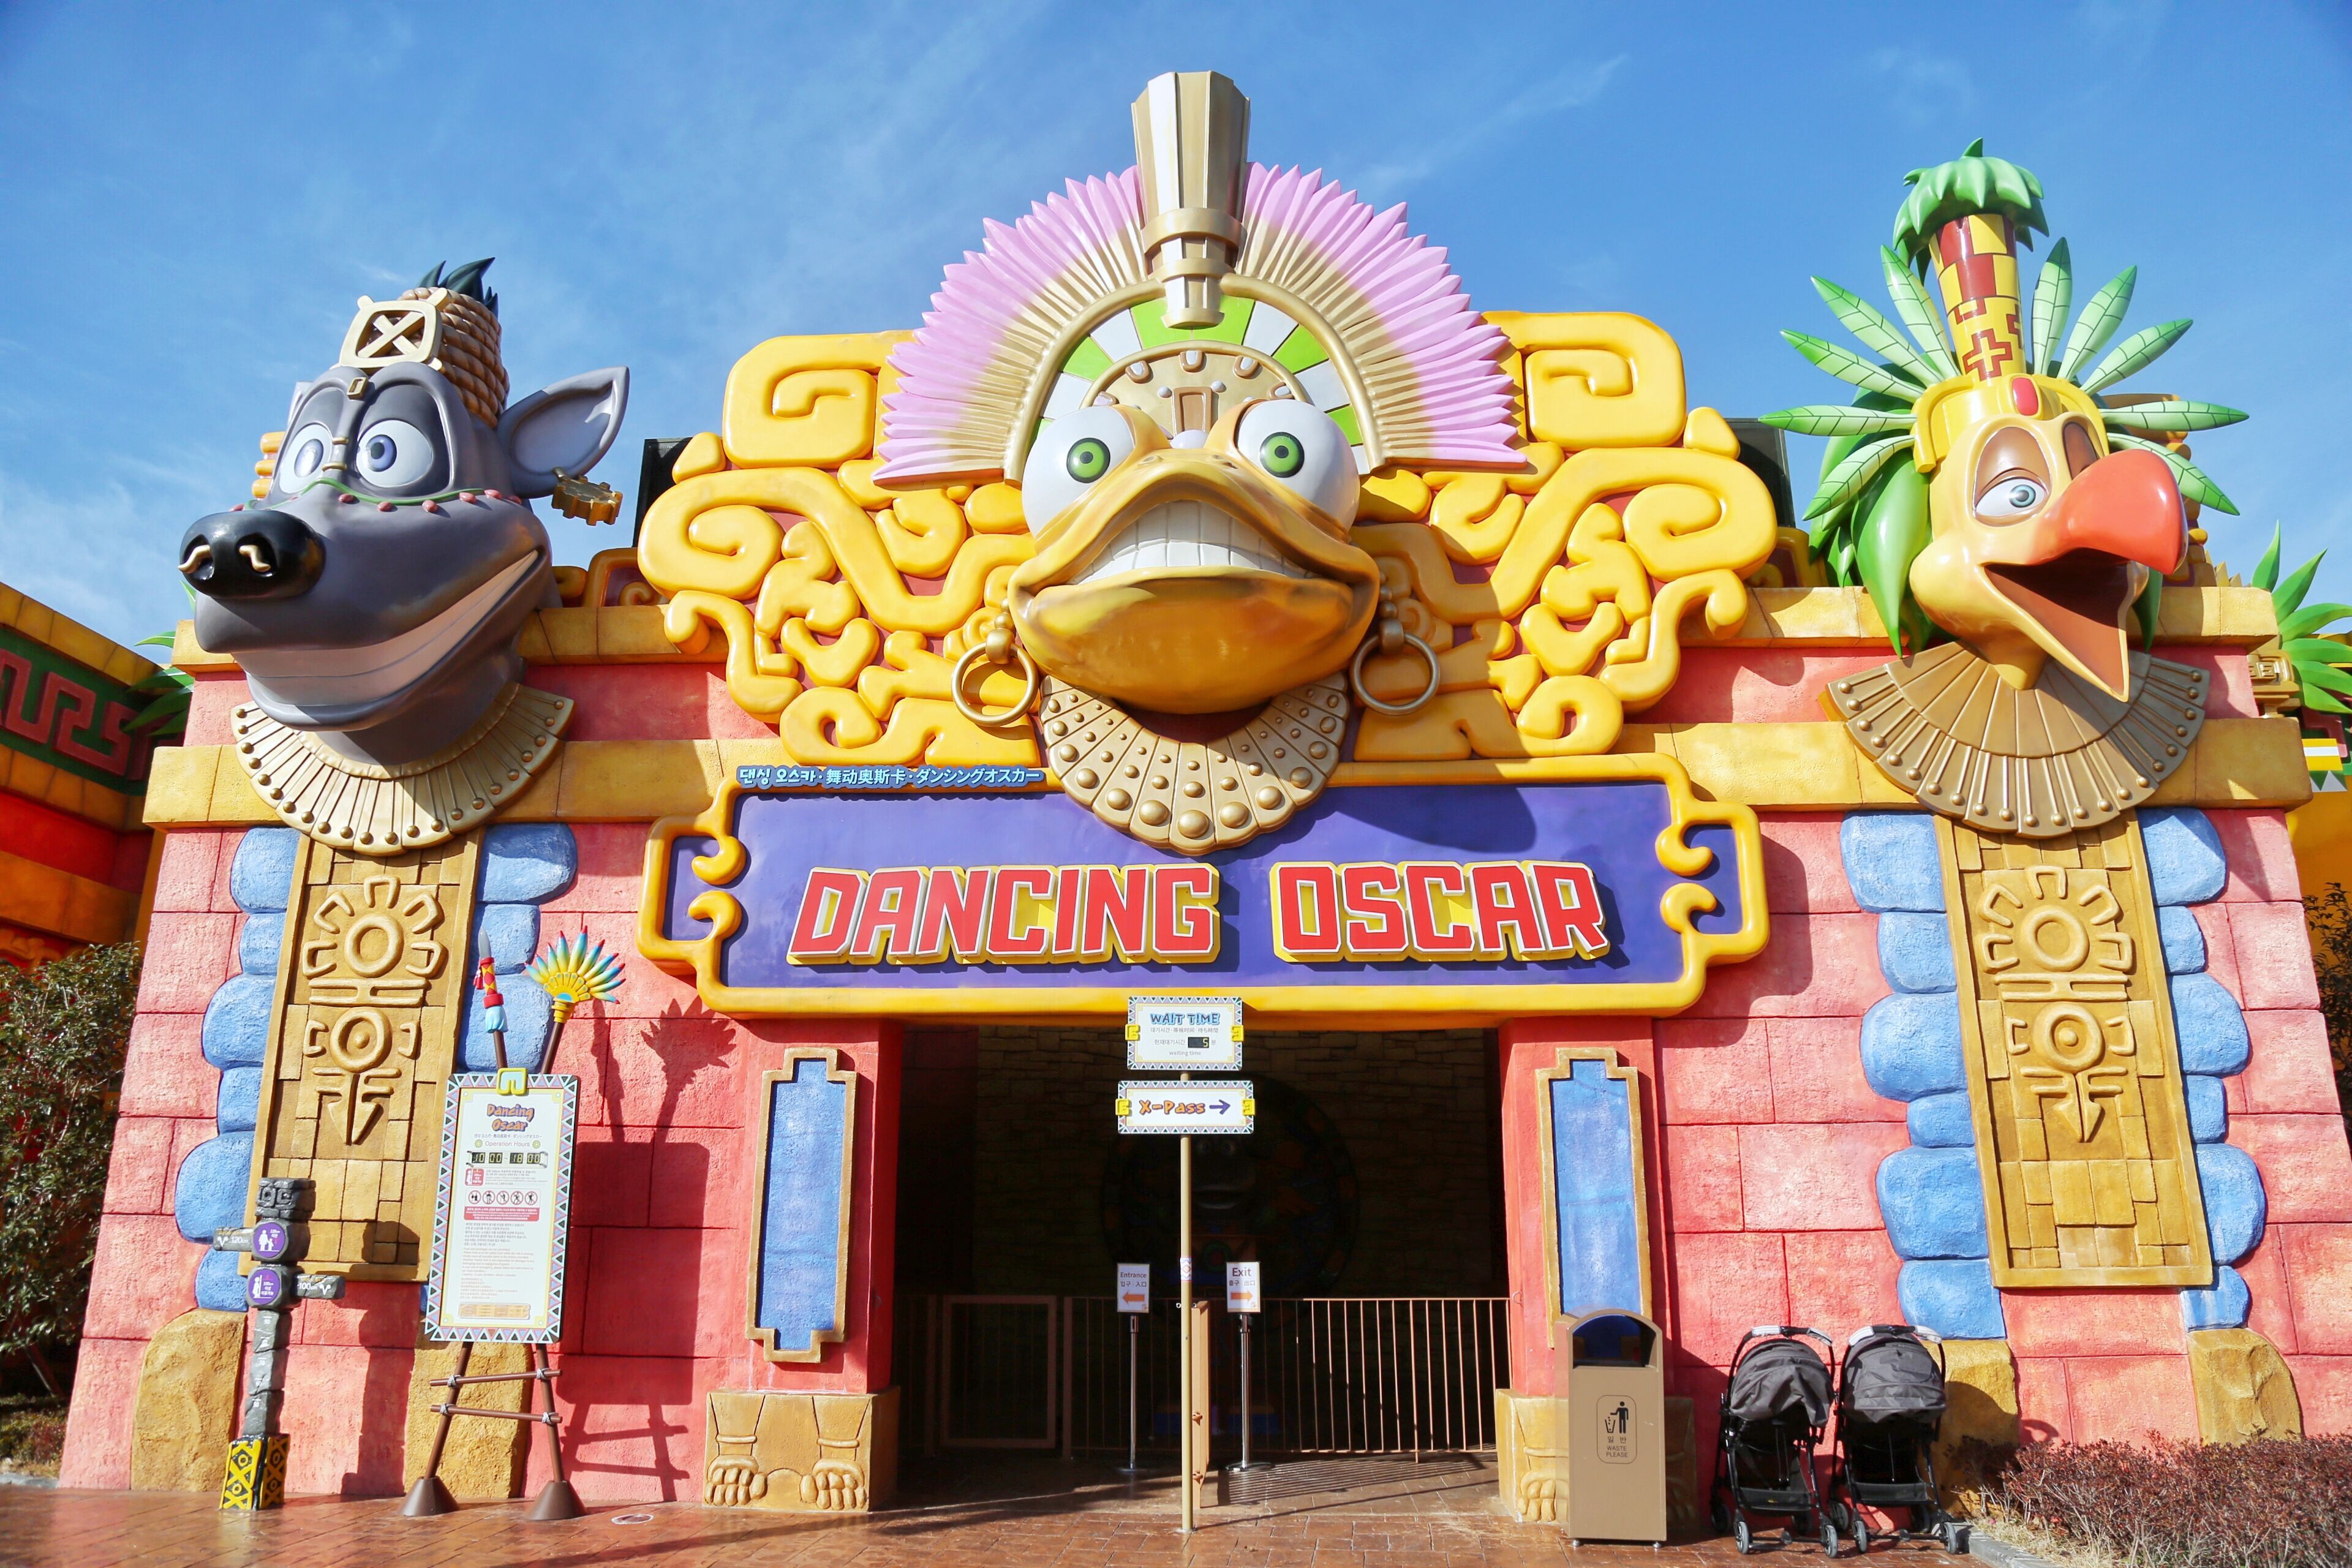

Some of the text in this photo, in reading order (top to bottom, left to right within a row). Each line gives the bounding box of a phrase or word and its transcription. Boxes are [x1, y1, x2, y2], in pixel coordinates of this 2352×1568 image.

[739, 768, 816, 785] 댄싱 오스카
[826, 769, 907, 785] 舞动奥斯卡
[916, 768, 1040, 784] ダンシングオスカー
[787, 861, 1611, 965] DANCING OSCAR
[1150, 1012, 1220, 1025] WAIT TIME
[1202, 1038, 1208, 1047] 5
[486, 1104, 535, 1122] Dancing
[1139, 1099, 1206, 1115] X-Pass
[492, 1118, 528, 1131] Oscar
[1232, 1267, 1252, 1276] Exit
